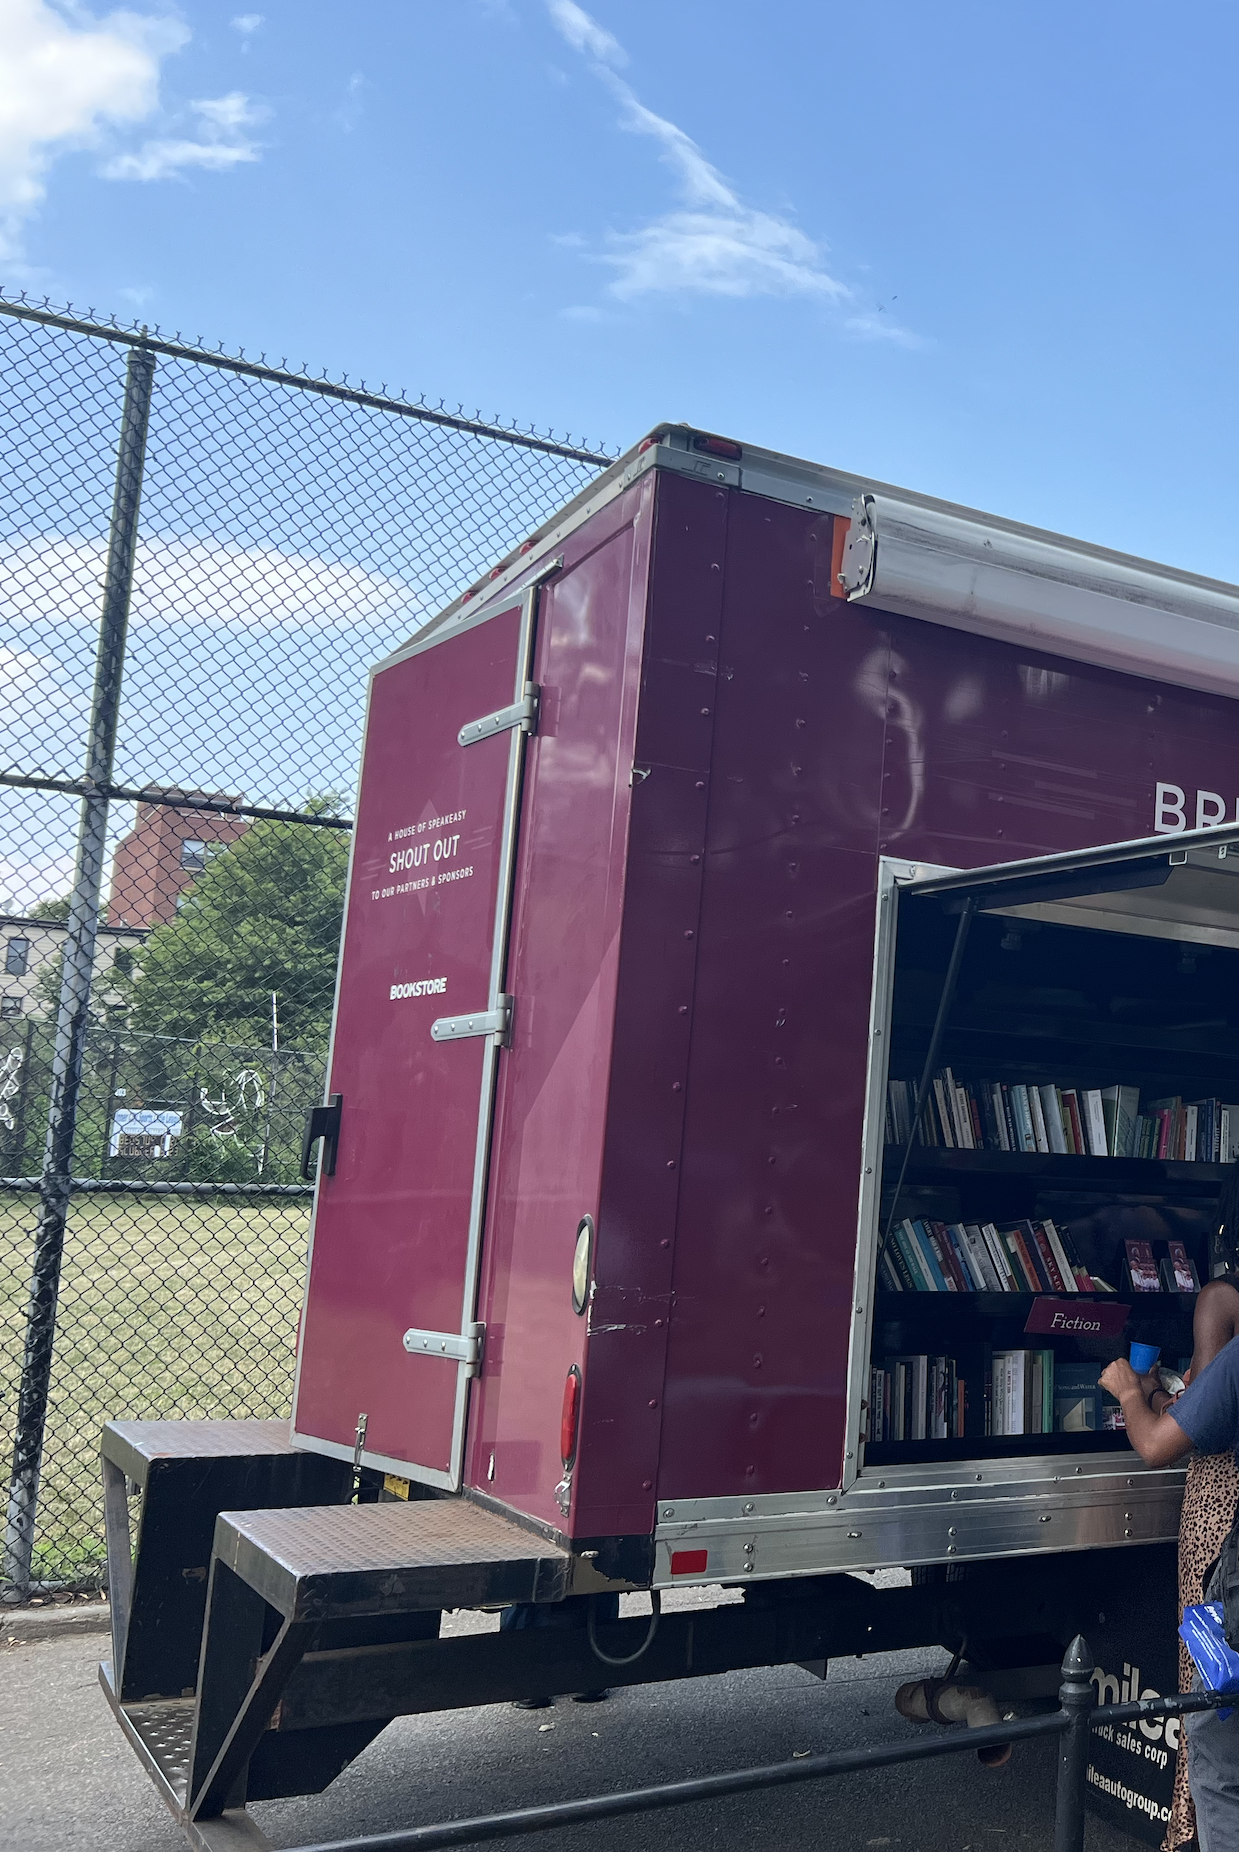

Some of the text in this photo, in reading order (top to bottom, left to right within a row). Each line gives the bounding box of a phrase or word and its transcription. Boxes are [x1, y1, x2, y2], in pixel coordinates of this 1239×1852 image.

[387, 809, 467, 842] A HOUSE OF SPEAKEASY
[389, 834, 461, 874] SHOUT OUT
[371, 866, 474, 901] TO OUR PARTNERS & SPONSORS
[389, 977, 448, 1001] BOOKSTORE
[1050, 1313, 1101, 1332] Fiction
[1092, 1724, 1168, 1770] uck sales corp
